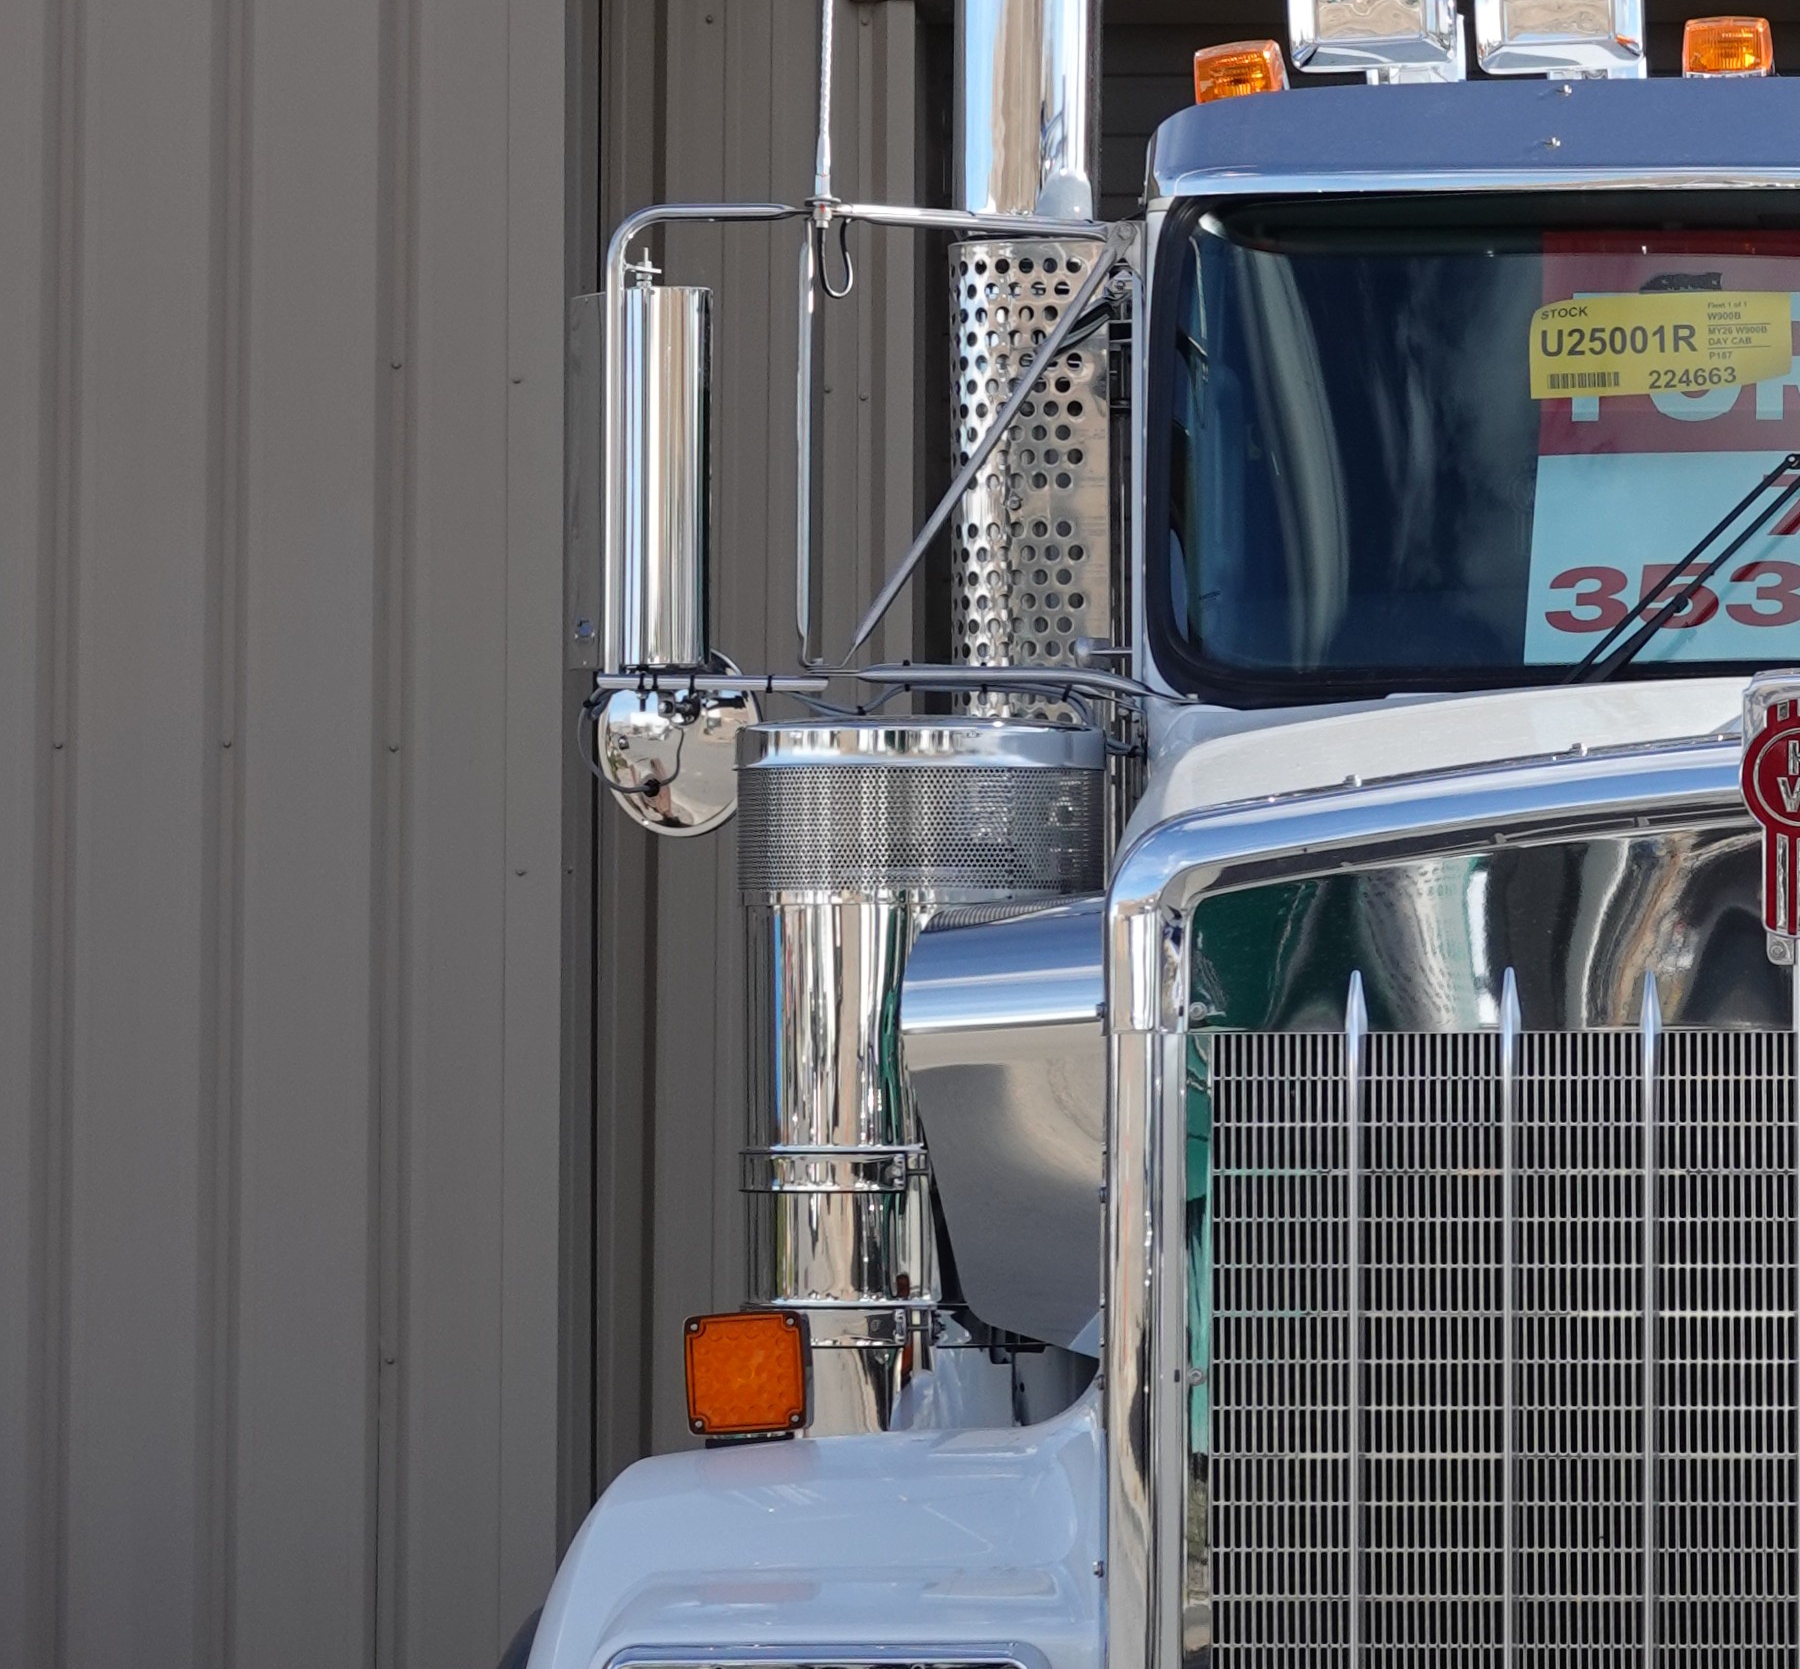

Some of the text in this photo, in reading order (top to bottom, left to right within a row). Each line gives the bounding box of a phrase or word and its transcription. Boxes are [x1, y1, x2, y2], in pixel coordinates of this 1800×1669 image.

[1540, 306, 1588, 321] STOCK
[1707, 312, 1741, 321] W900B
[1540, 324, 1699, 357] U25001R
[1708, 336, 1752, 346] DAY CAB
[1648, 366, 1737, 390] 224663
